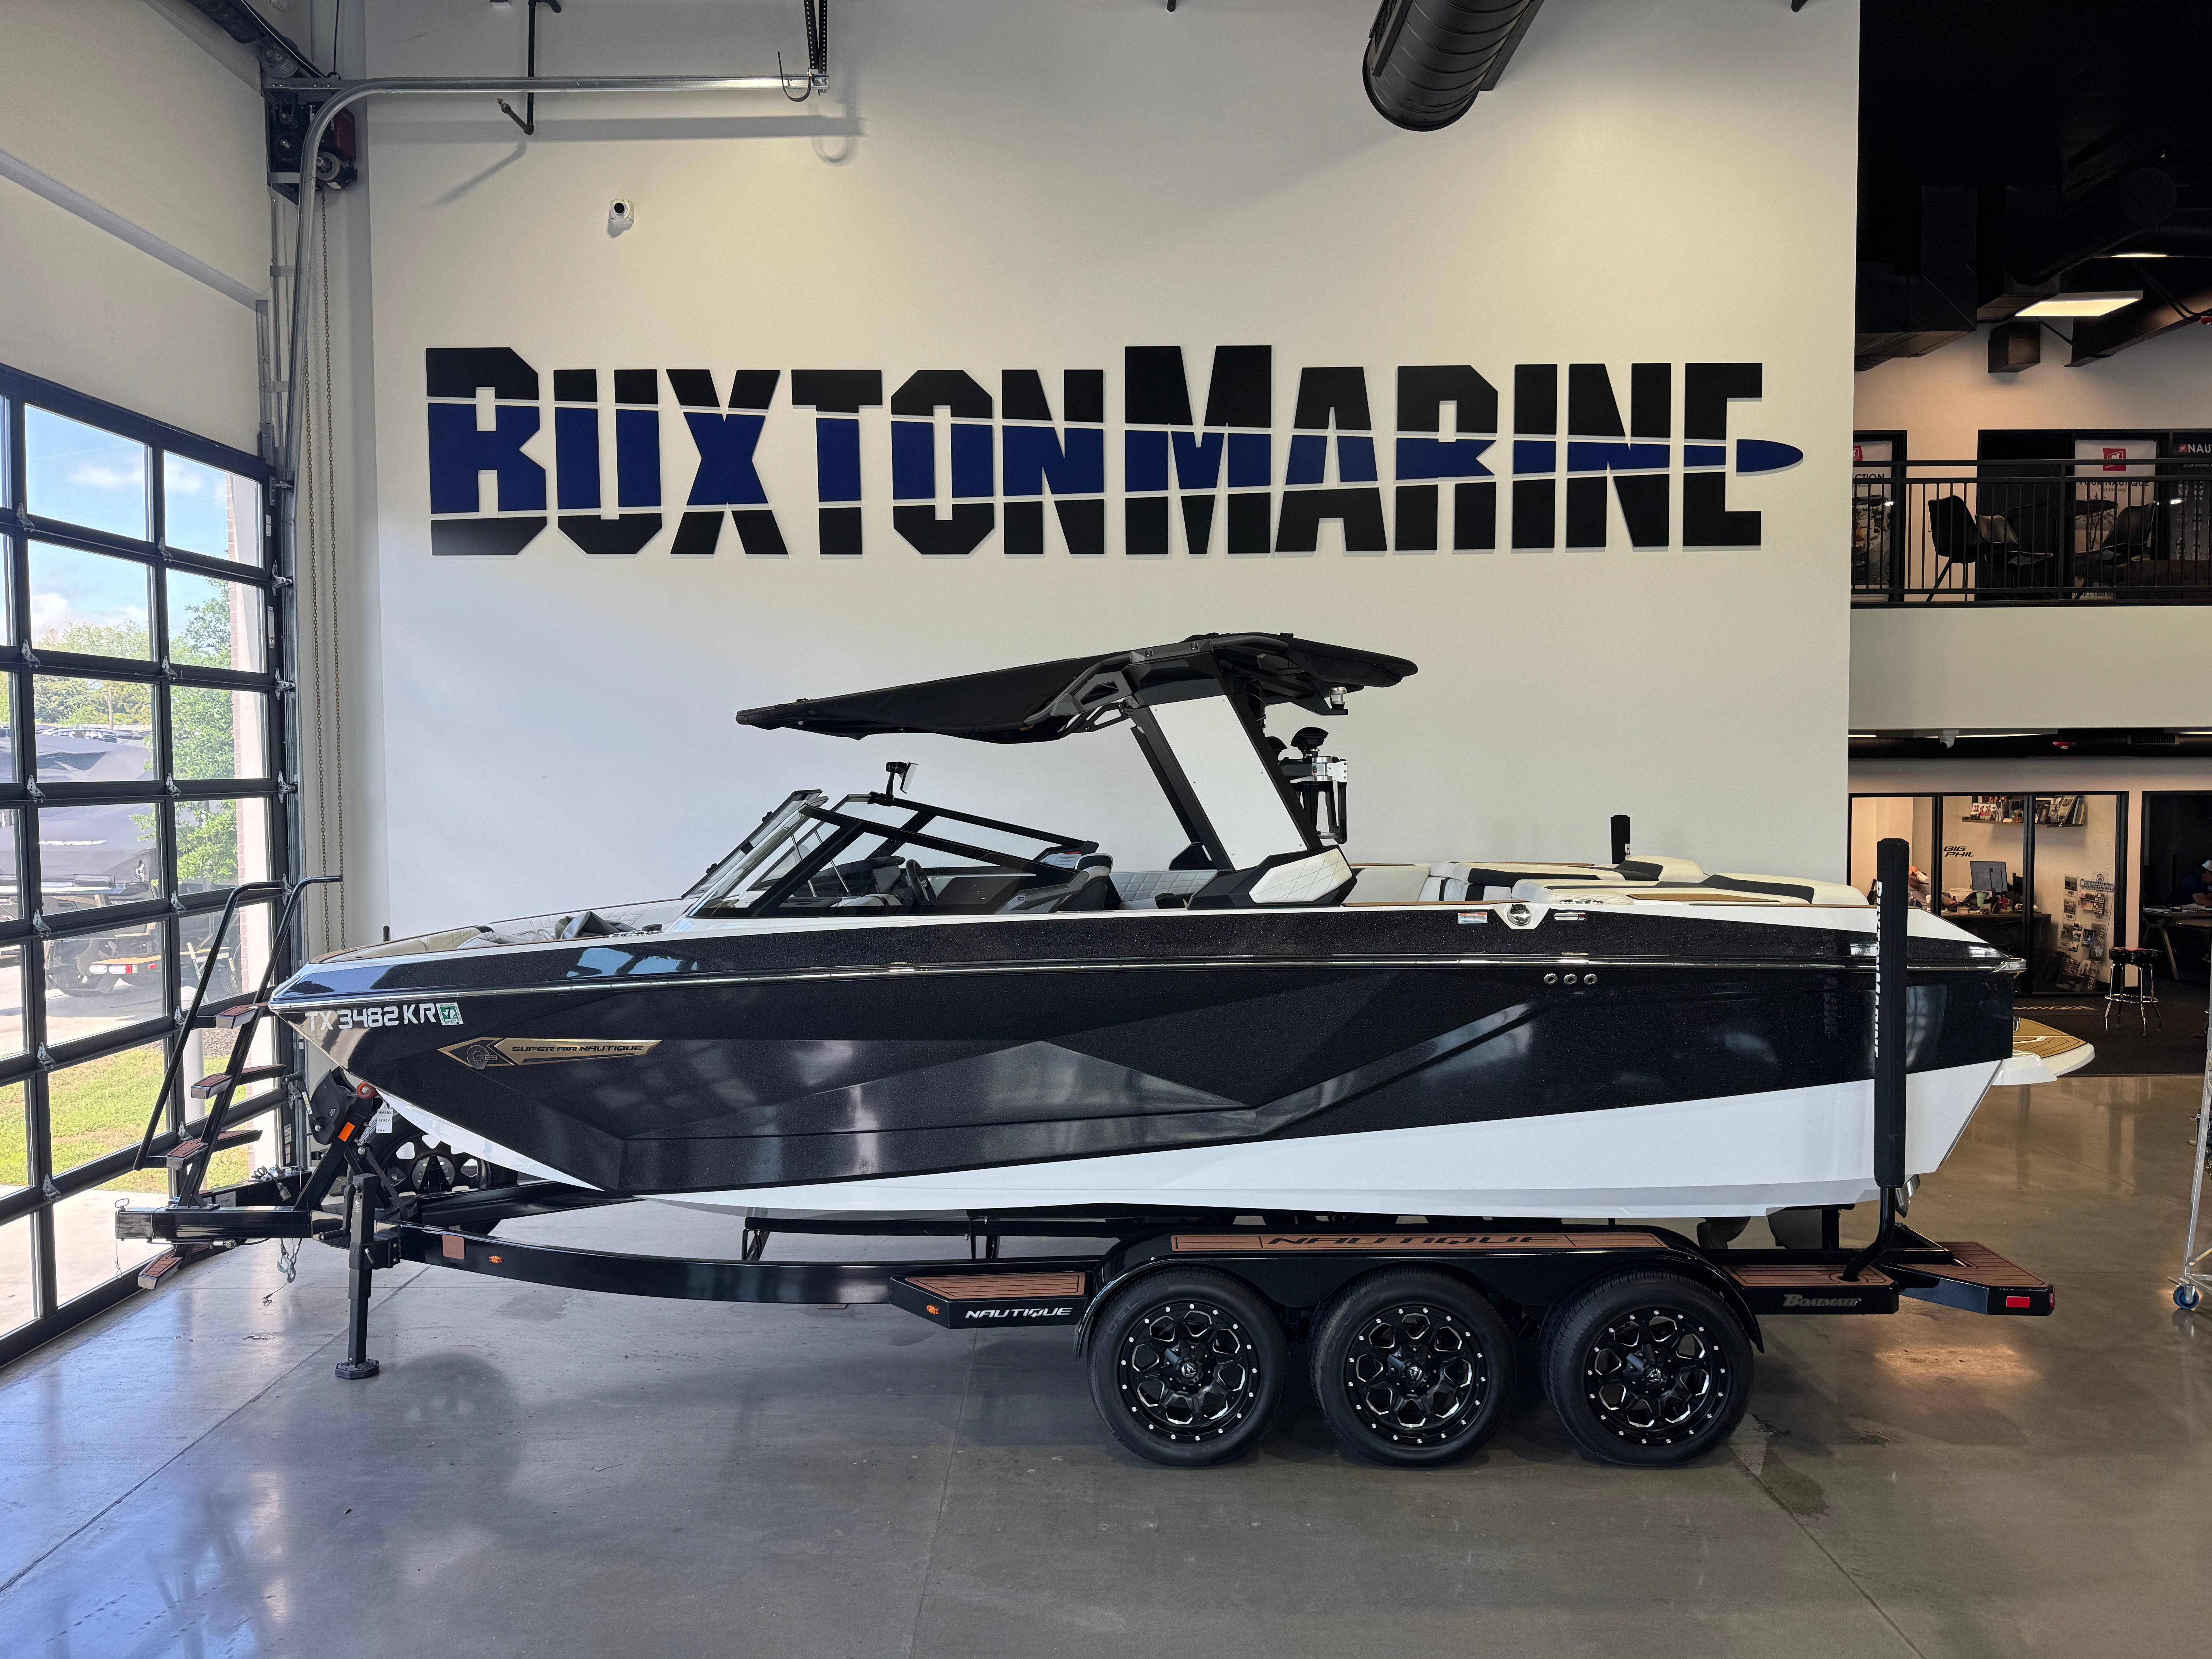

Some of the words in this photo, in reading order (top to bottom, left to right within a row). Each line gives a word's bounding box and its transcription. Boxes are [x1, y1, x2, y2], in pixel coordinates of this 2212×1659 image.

[305, 1010, 333, 1031] TX
[337, 1006, 399, 1029] 3482
[403, 1003, 436, 1025] KR
[1267, 1236, 1562, 1245] NAUTIQUE
[1783, 1293, 1858, 1307] BOATMATE
[965, 1307, 1073, 1319] NAUTIQUE
